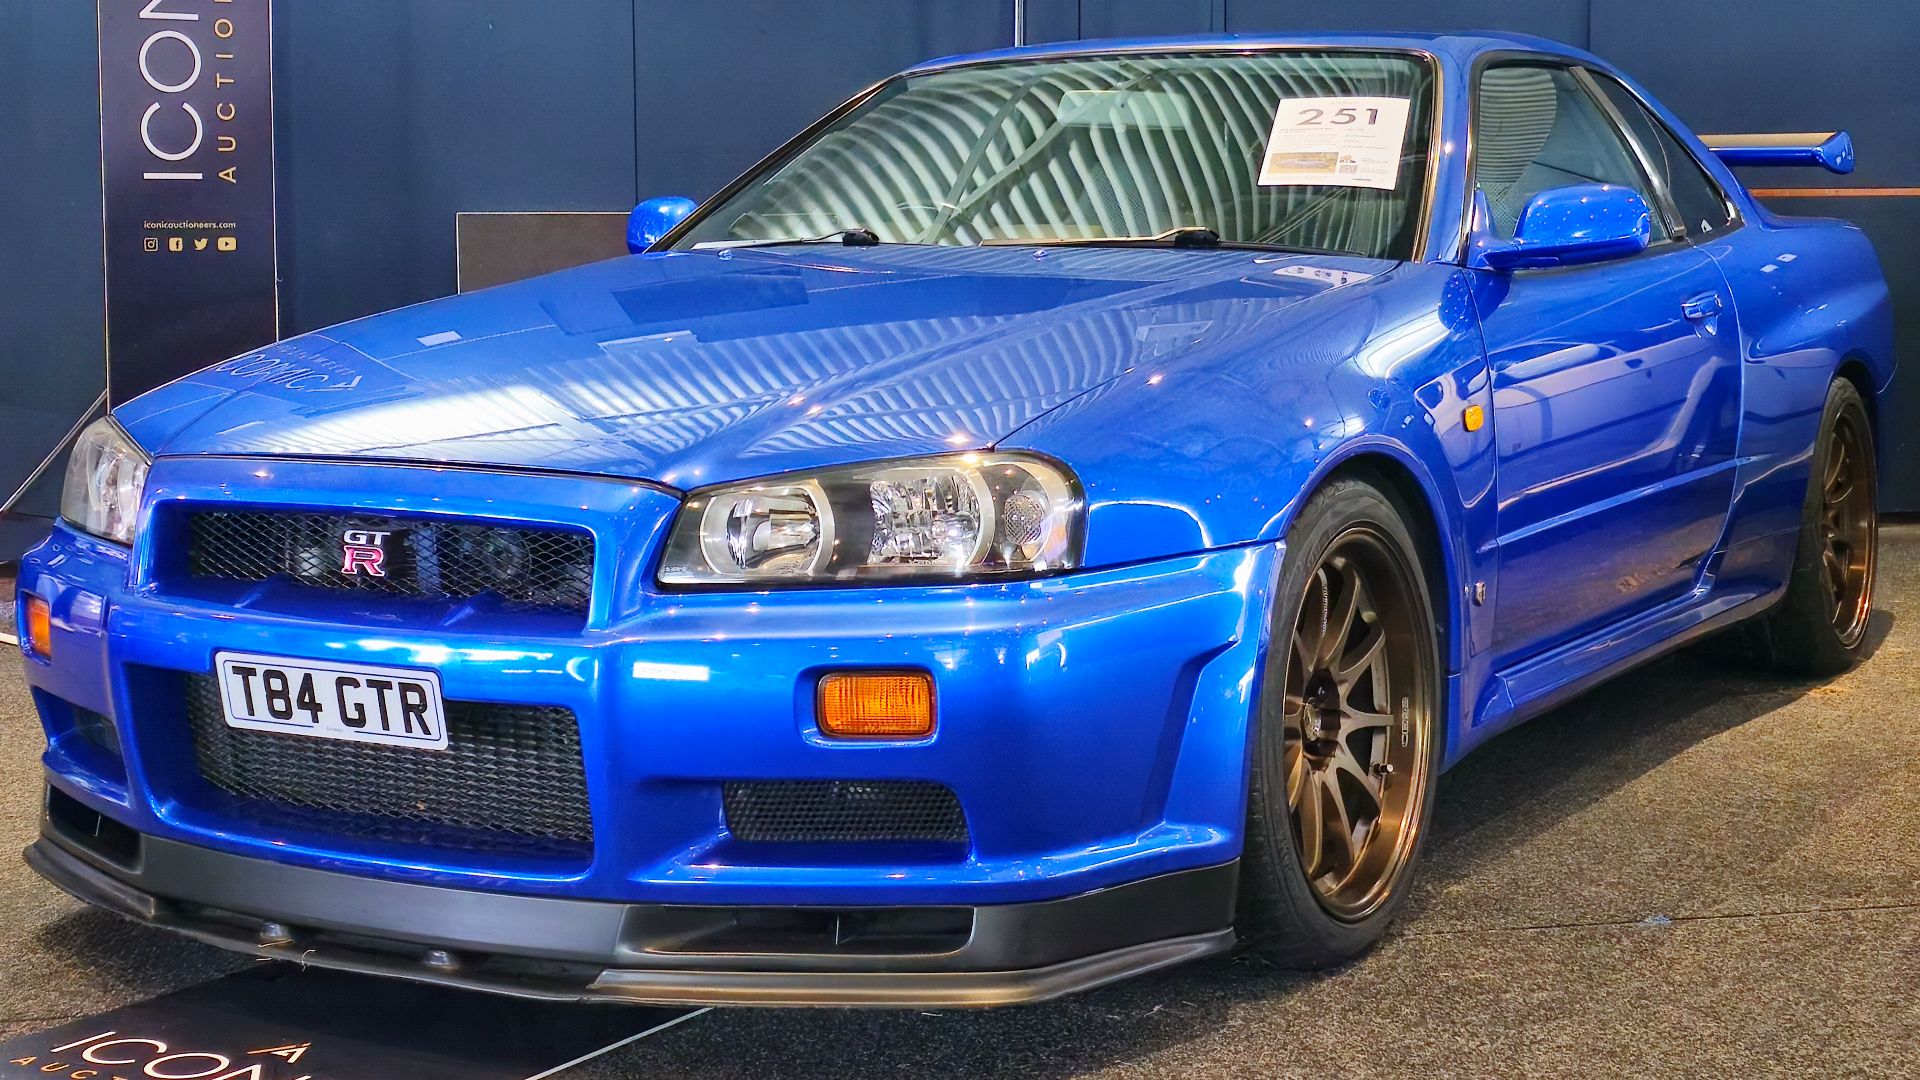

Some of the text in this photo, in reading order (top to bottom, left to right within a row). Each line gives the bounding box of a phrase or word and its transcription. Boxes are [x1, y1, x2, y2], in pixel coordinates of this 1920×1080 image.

[213, 0, 237, 184] AUCTIO
[1296, 107, 1379, 126] 251
[143, 220, 236, 230] iconicauctioneers.com
[343, 529, 391, 546] GT
[340, 544, 386, 577] R
[231, 665, 432, 736] T84 GTR
[8, 1056, 128, 1080] AUC
